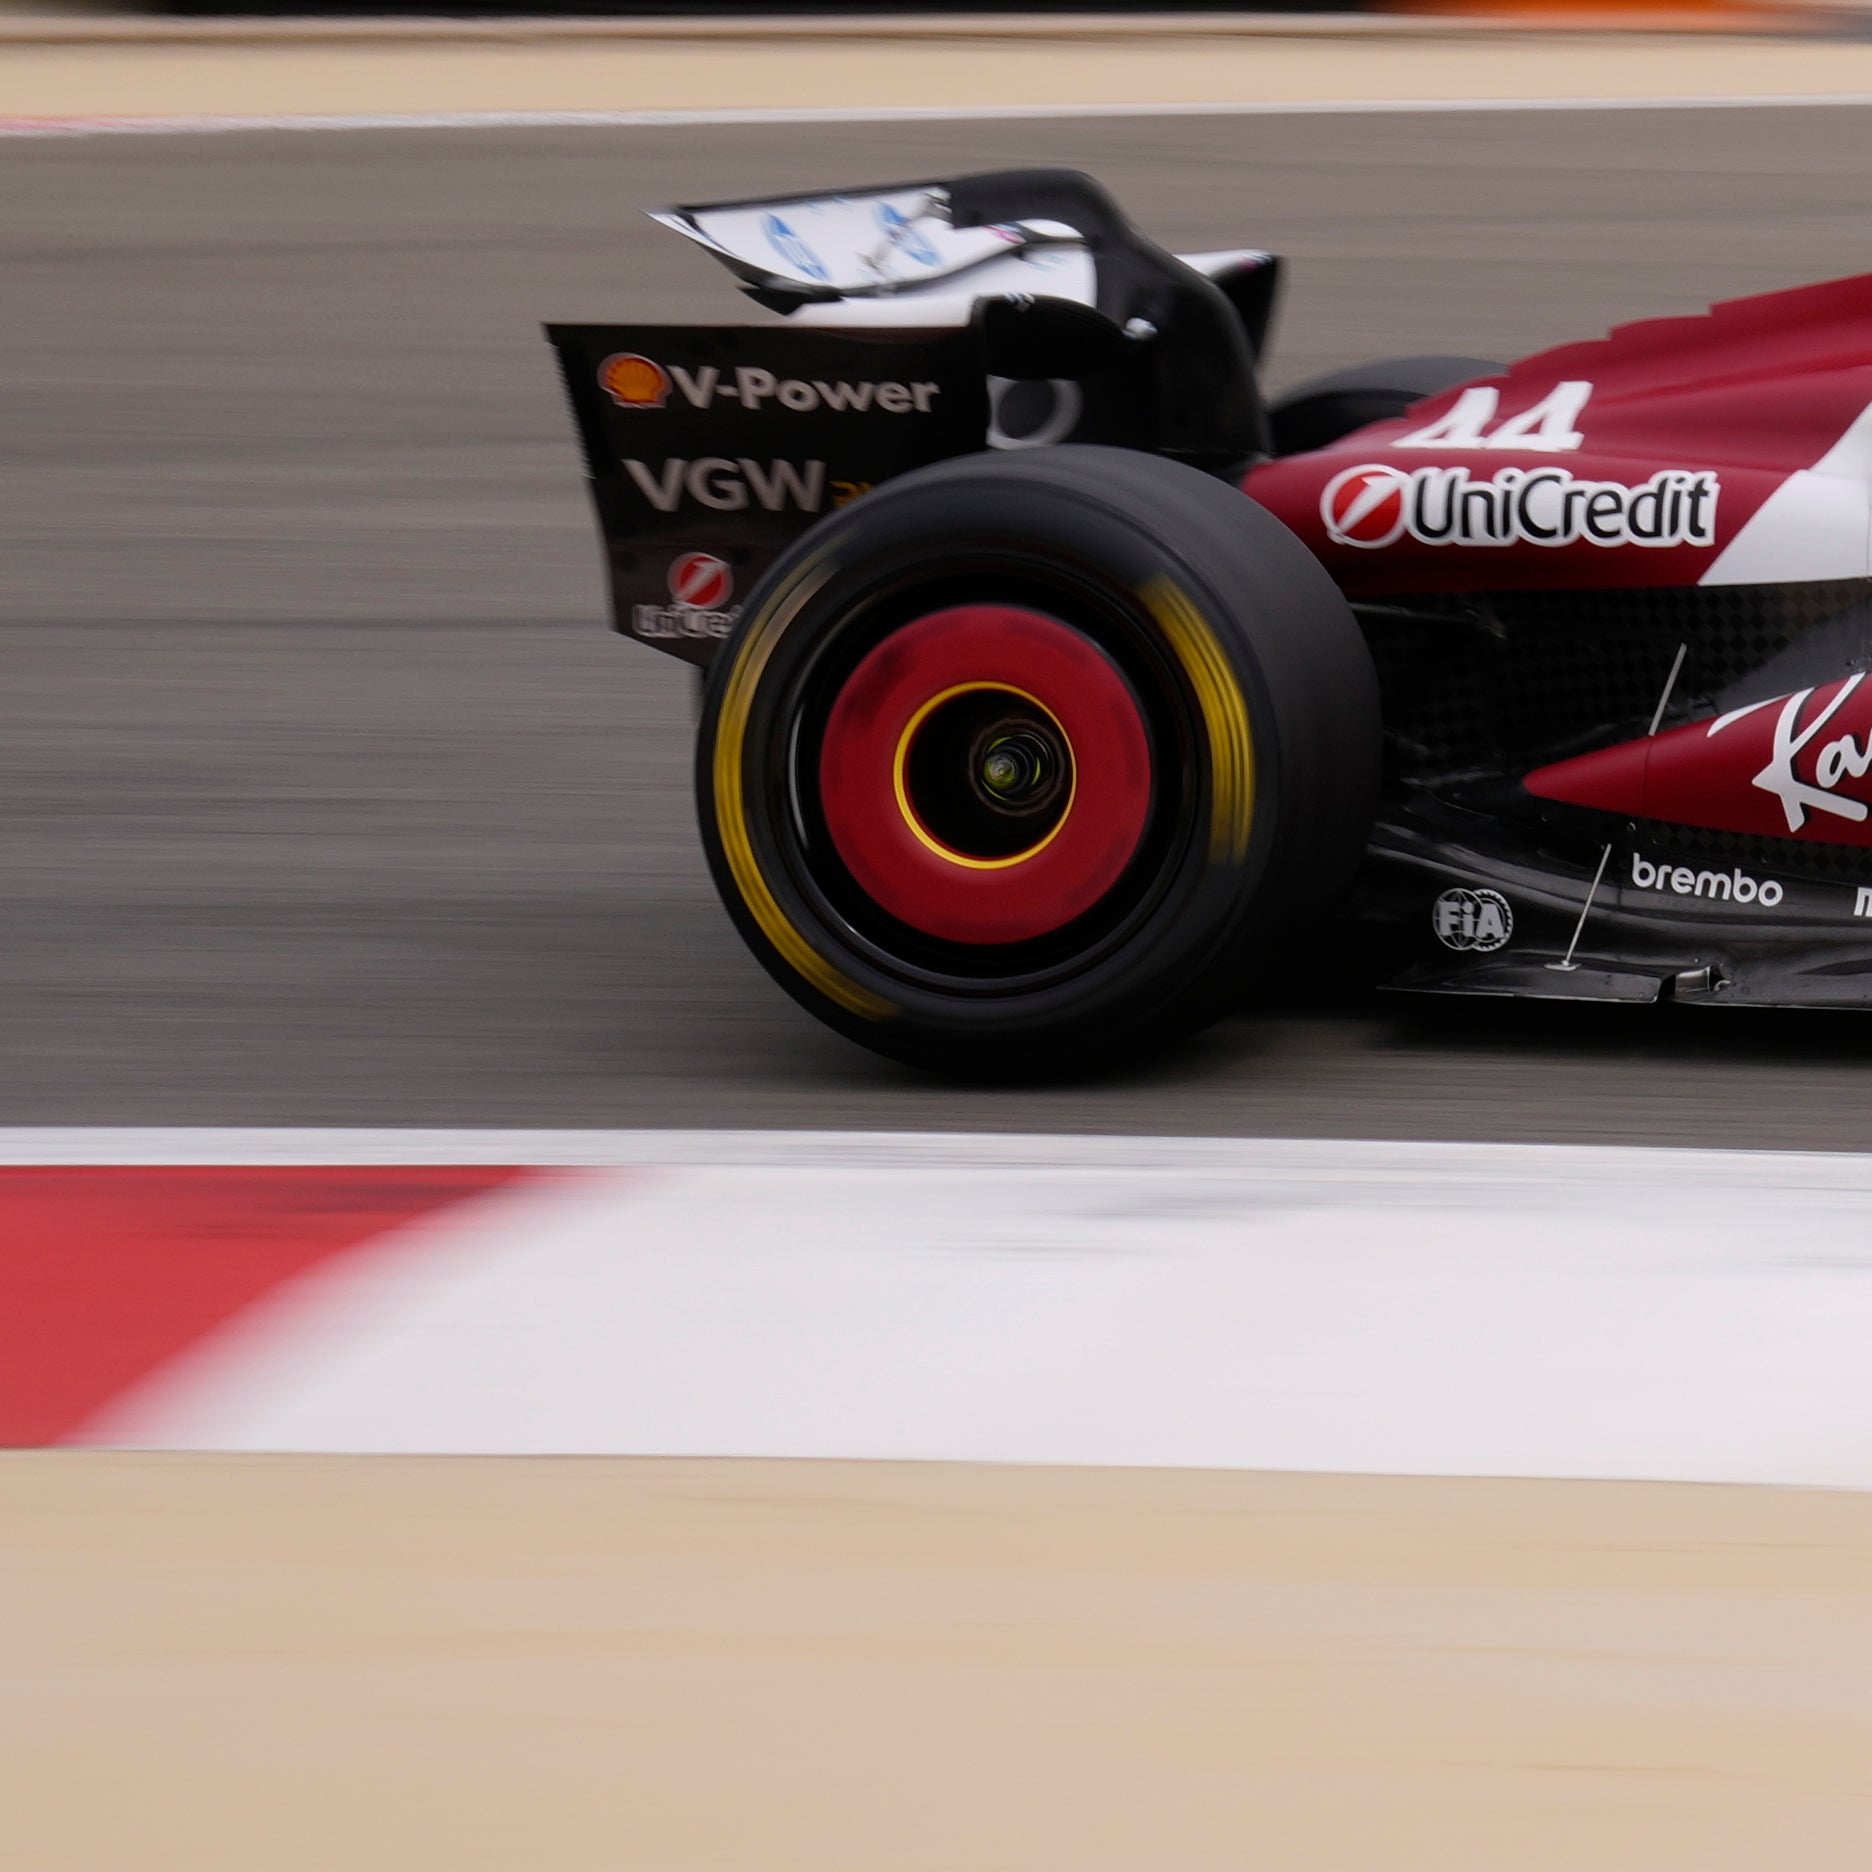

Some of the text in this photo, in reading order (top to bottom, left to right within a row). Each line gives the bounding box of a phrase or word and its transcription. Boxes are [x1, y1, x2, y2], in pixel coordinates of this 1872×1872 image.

[669, 364, 940, 414] V-Power
[1391, 380, 1593, 451] 44
[621, 456, 827, 513] VGW
[1412, 466, 1724, 548] UniCredit
[1631, 853, 1784, 908] brembo
